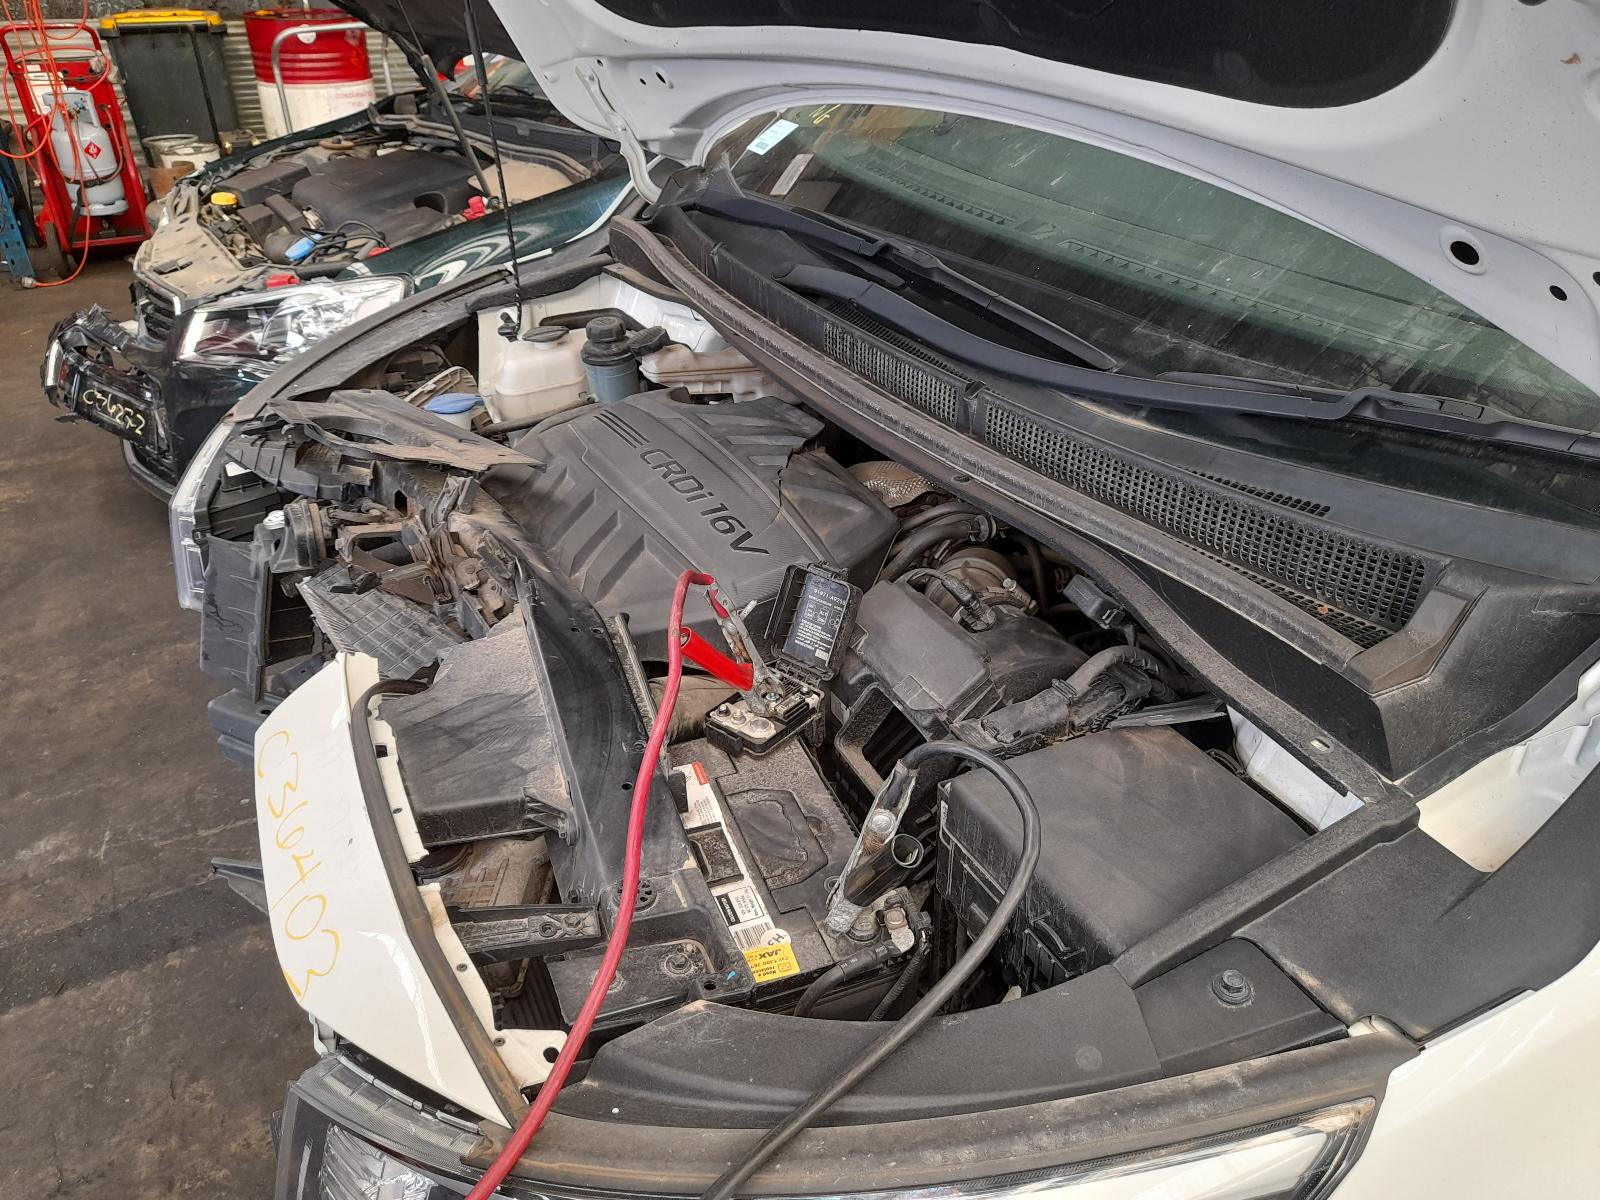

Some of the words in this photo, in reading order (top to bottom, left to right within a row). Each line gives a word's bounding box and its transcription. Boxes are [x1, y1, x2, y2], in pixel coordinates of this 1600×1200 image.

[639, 448, 715, 503] CRDi
[700, 502, 770, 555] 16V
[758, 949, 782, 960] JAX
